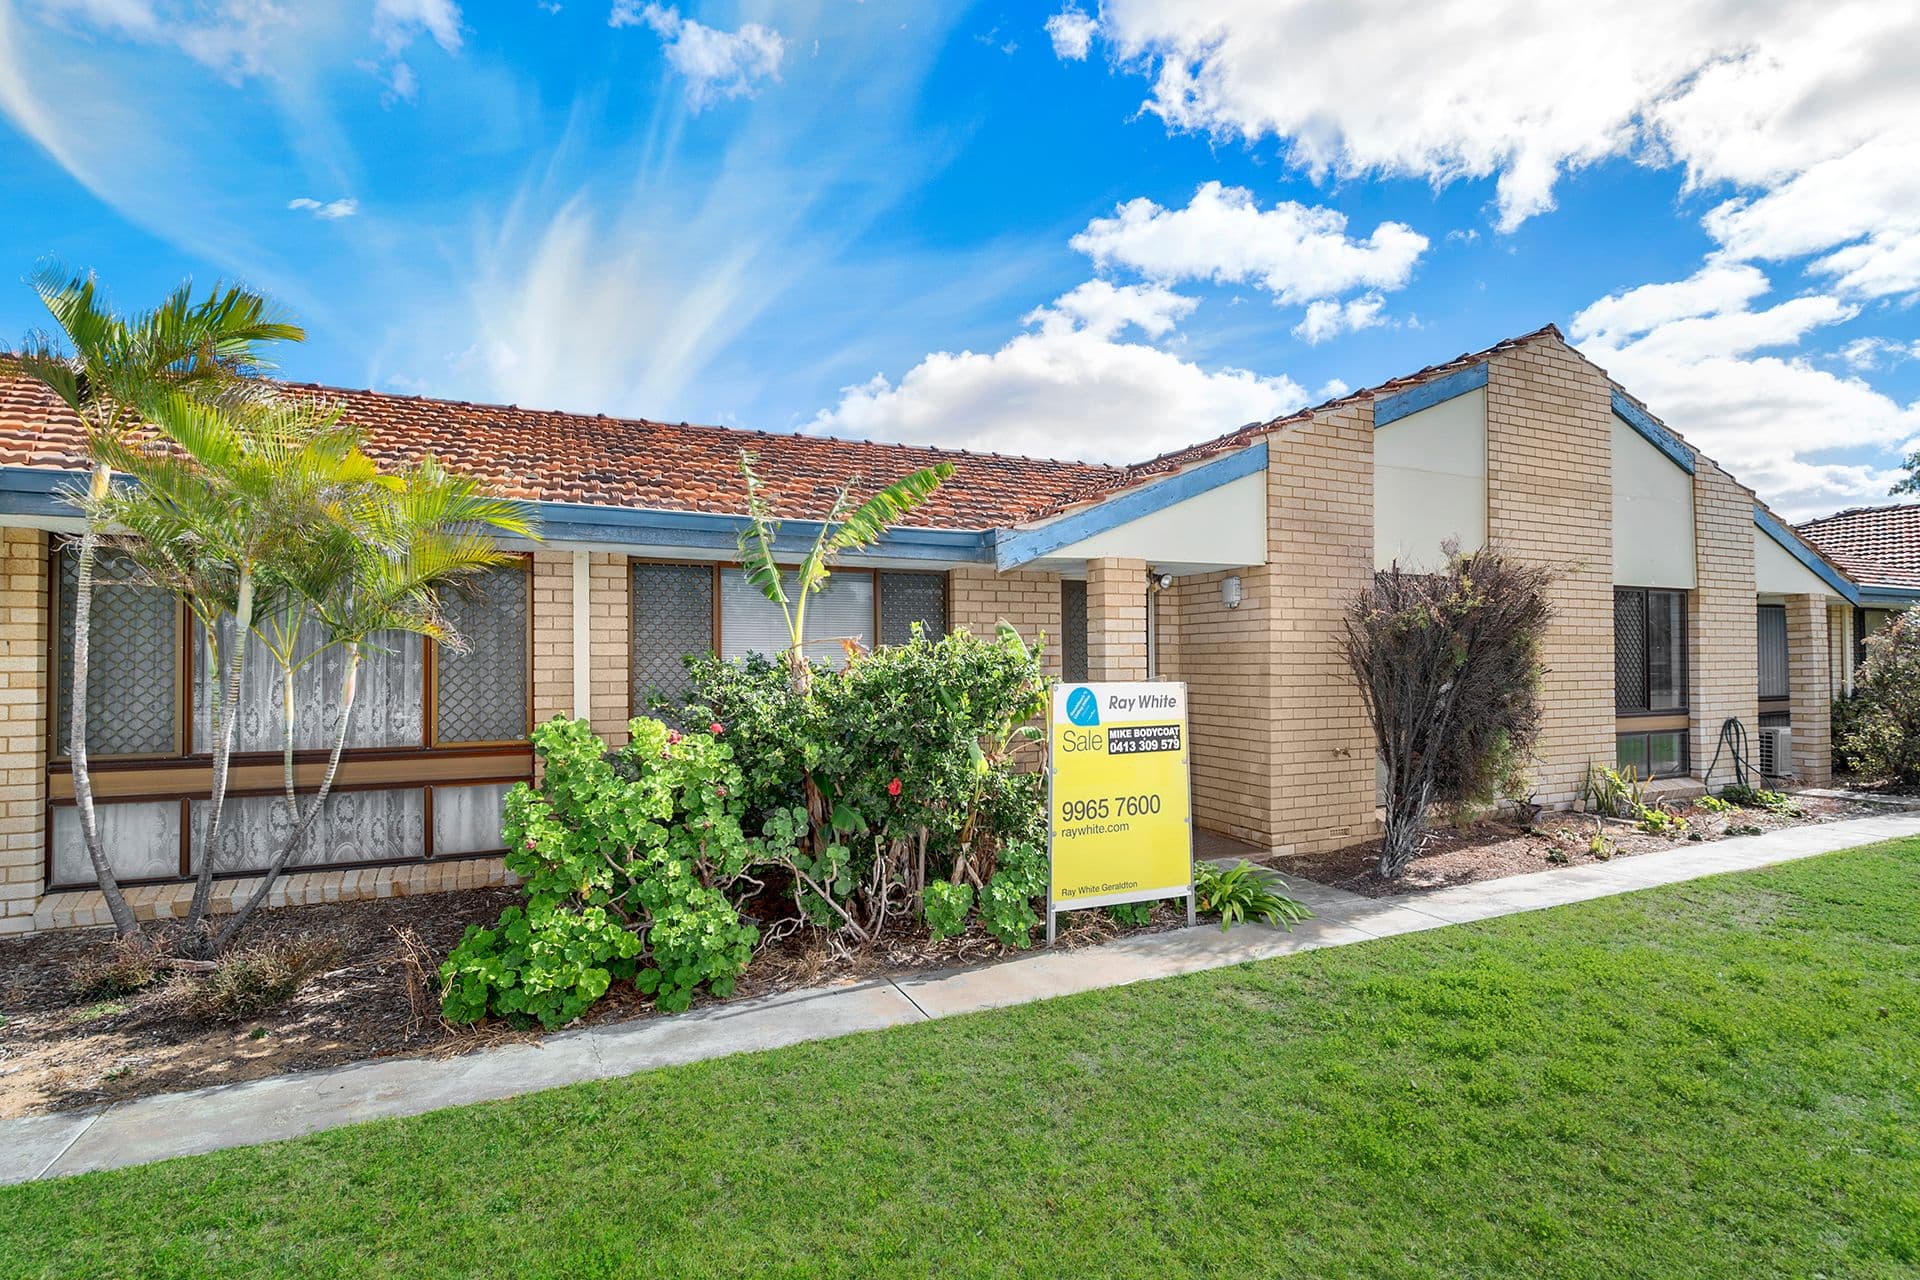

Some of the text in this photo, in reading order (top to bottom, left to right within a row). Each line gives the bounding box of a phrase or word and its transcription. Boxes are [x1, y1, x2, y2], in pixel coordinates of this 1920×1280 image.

[1109, 695, 1177, 712] Ray White
[1063, 730, 1102, 752] Sale
[1109, 727, 1179, 739] MIKE BODYCOAT
[1110, 738, 1180, 753] 0413 309 579
[1062, 795, 1160, 821] 9965 7600
[1061, 822, 1129, 839] raywhite.com
[1061, 881, 1137, 897] Ray White Geraldton
